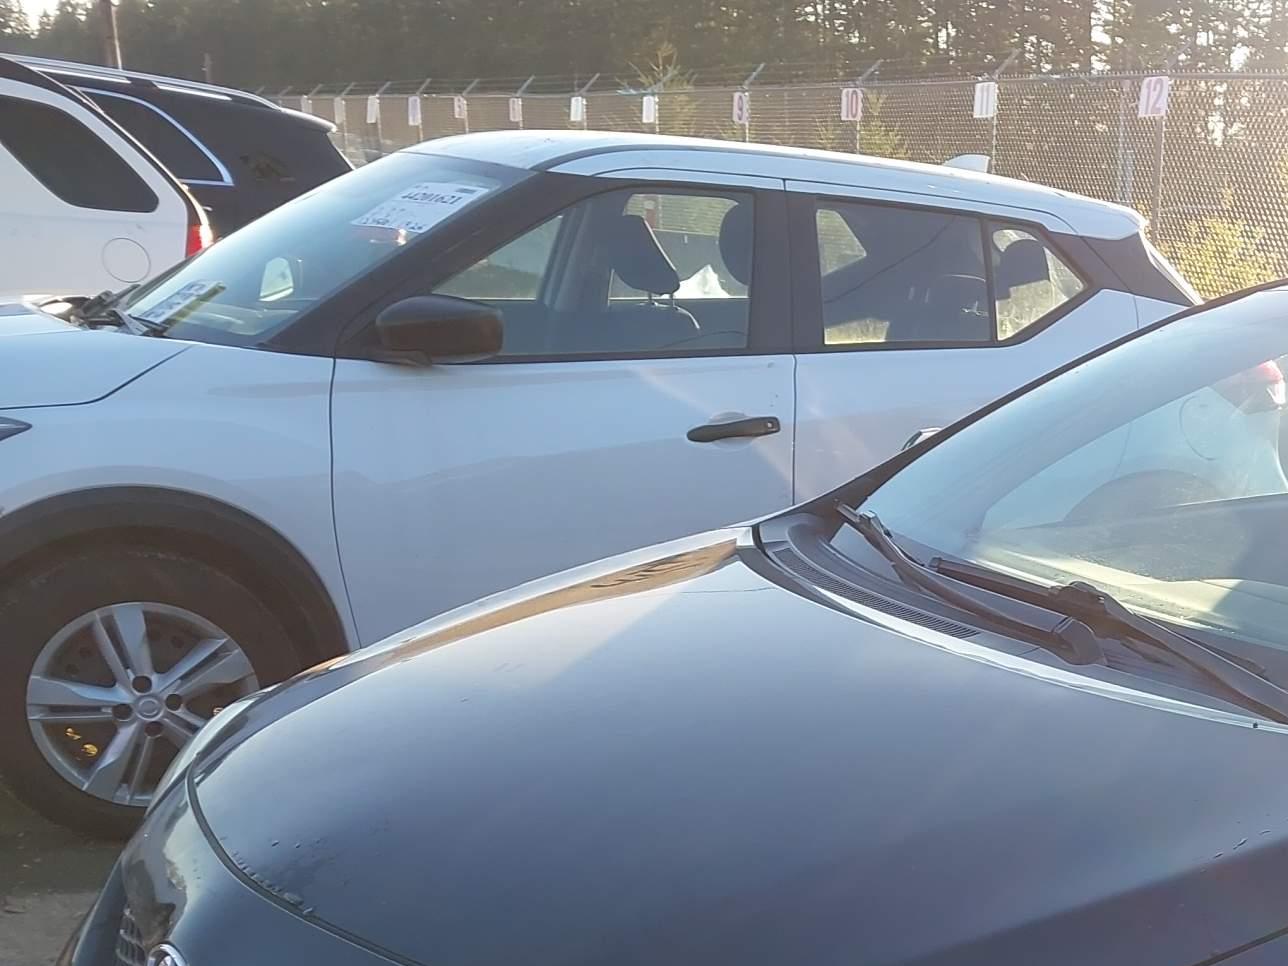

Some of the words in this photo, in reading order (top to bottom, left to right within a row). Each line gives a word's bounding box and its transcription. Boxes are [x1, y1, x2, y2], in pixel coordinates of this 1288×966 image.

[737, 95, 744, 121] 9
[845, 89, 859, 118] 10
[979, 84, 992, 116] 11
[1144, 79, 1163, 115] 12
